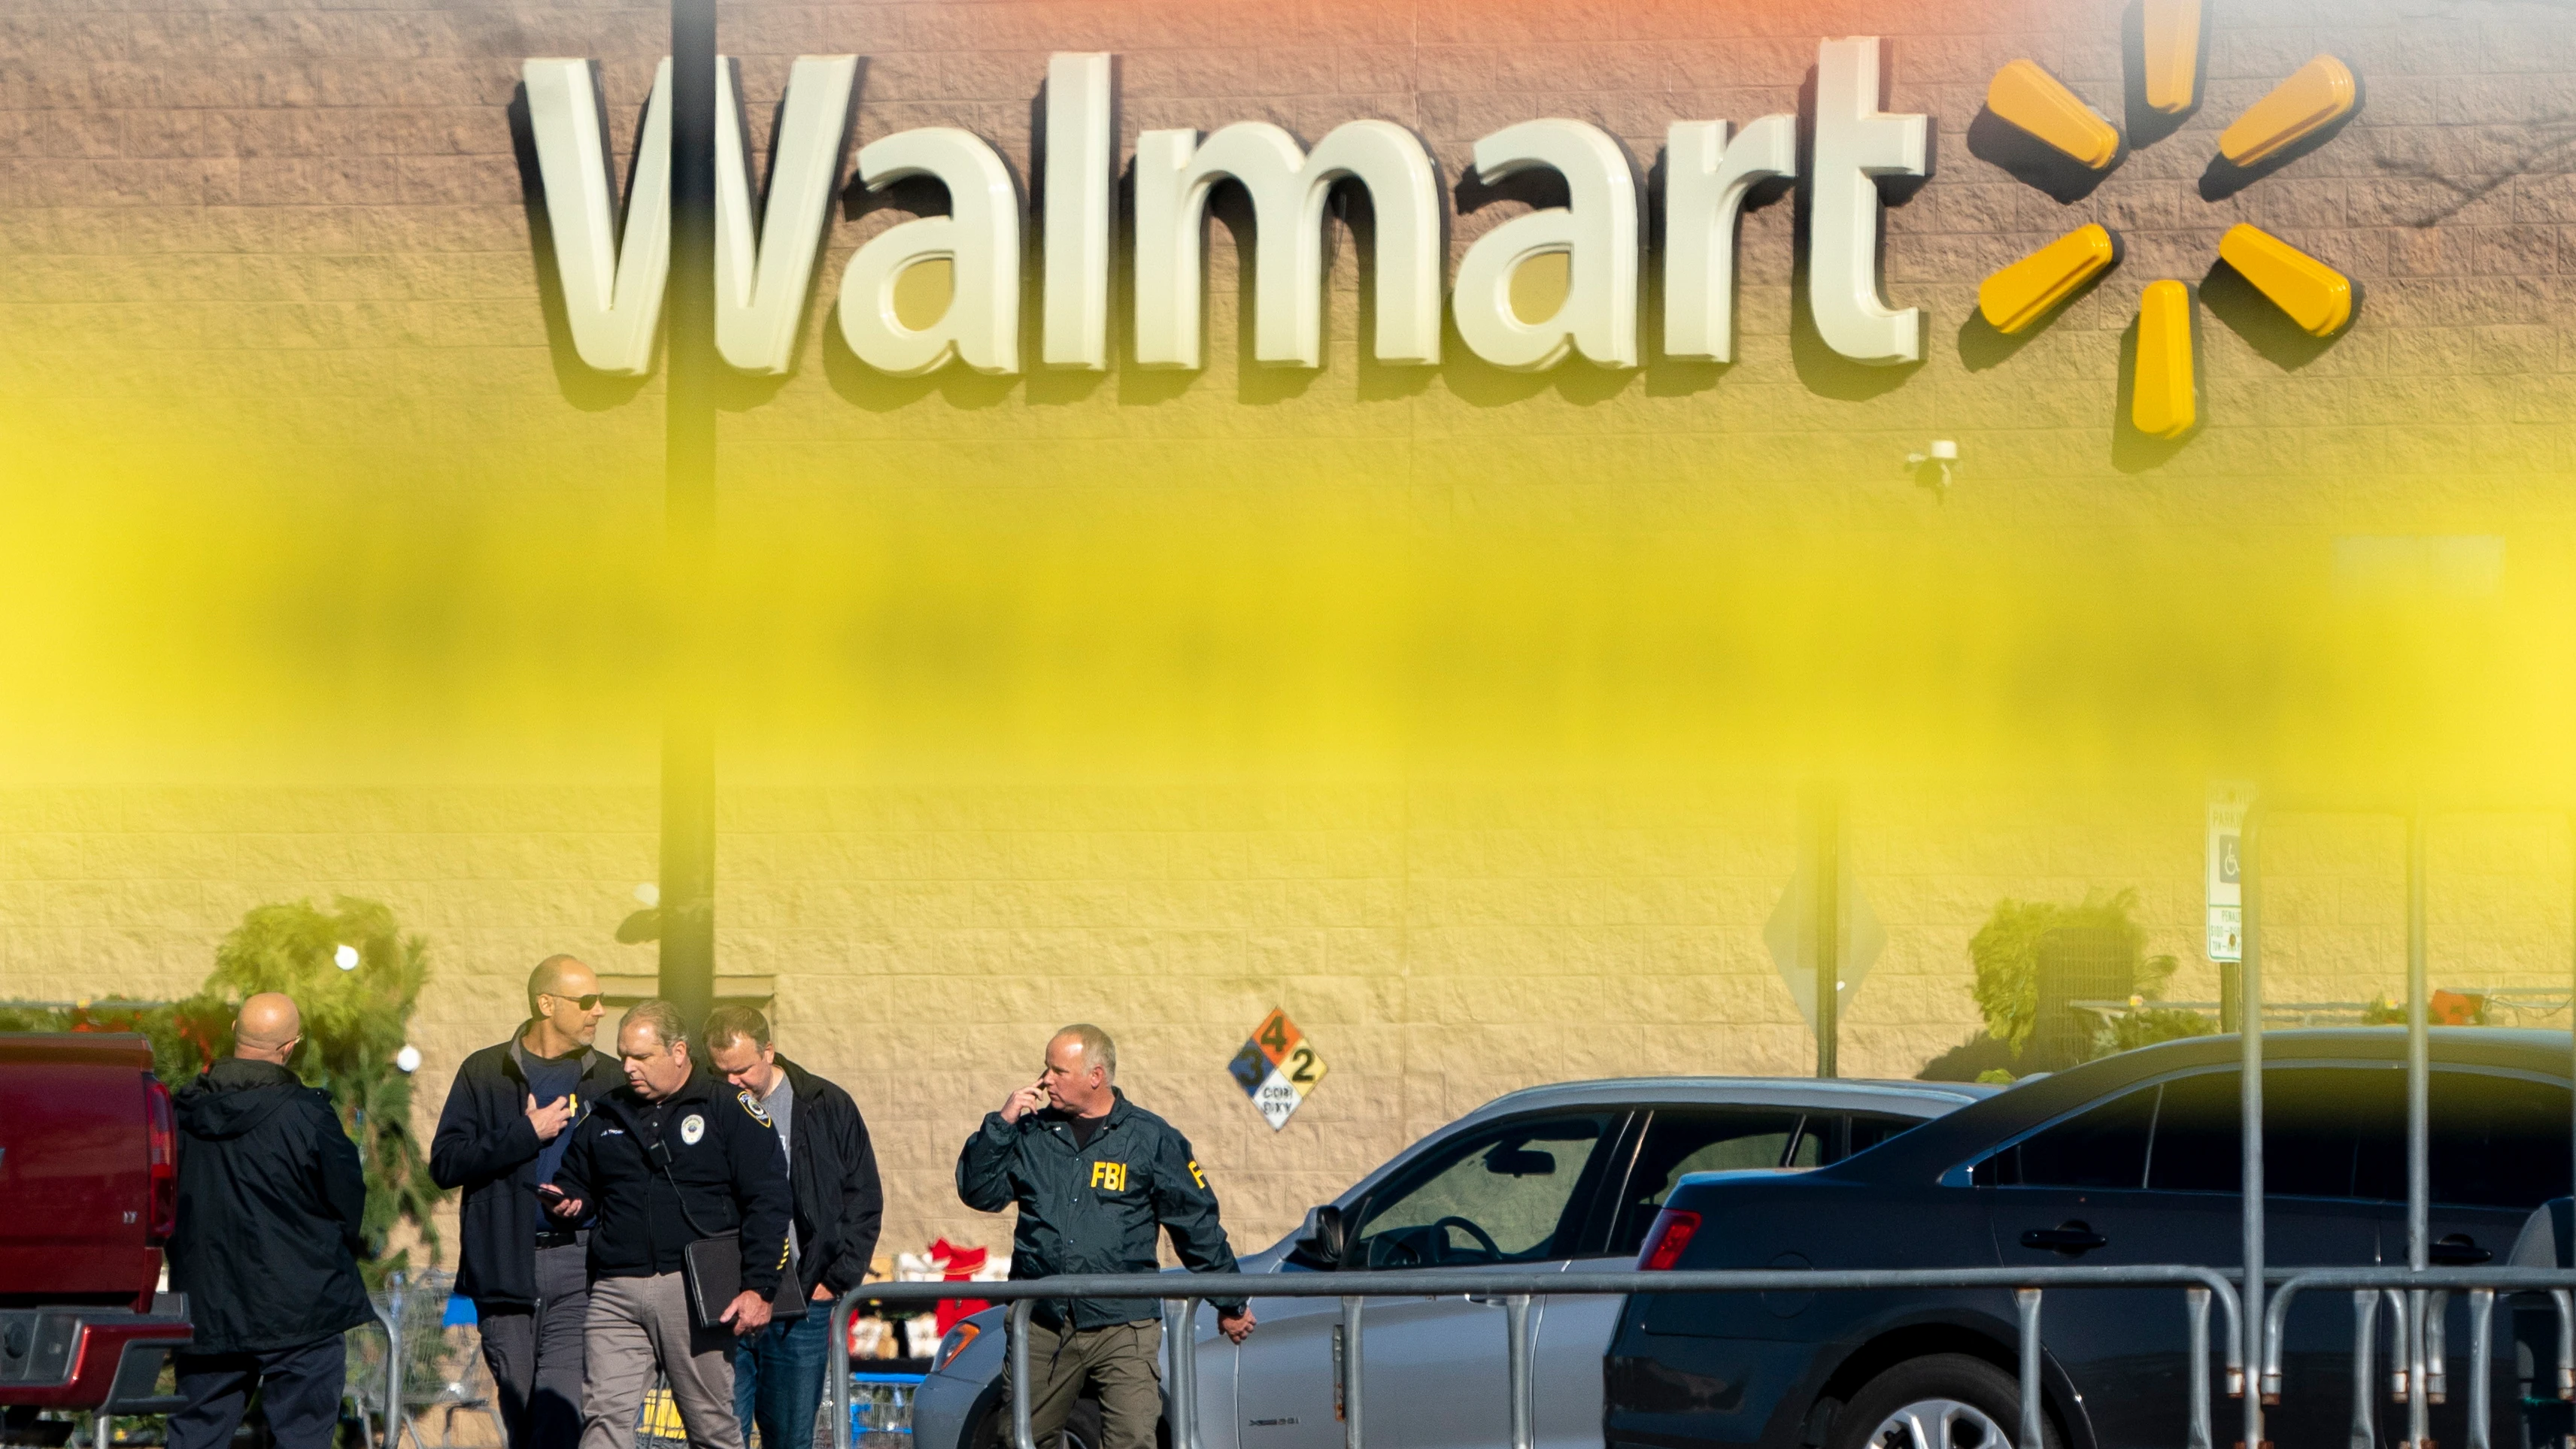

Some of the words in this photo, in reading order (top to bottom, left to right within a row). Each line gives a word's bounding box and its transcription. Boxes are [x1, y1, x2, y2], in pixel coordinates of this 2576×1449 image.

[523, 35, 1928, 376] Walmart
[1261, 1017, 1287, 1052] 4
[1238, 1048, 1264, 1086] 3
[1291, 1048, 1316, 1083] 2
[1091, 1161, 1127, 1192] FBI
